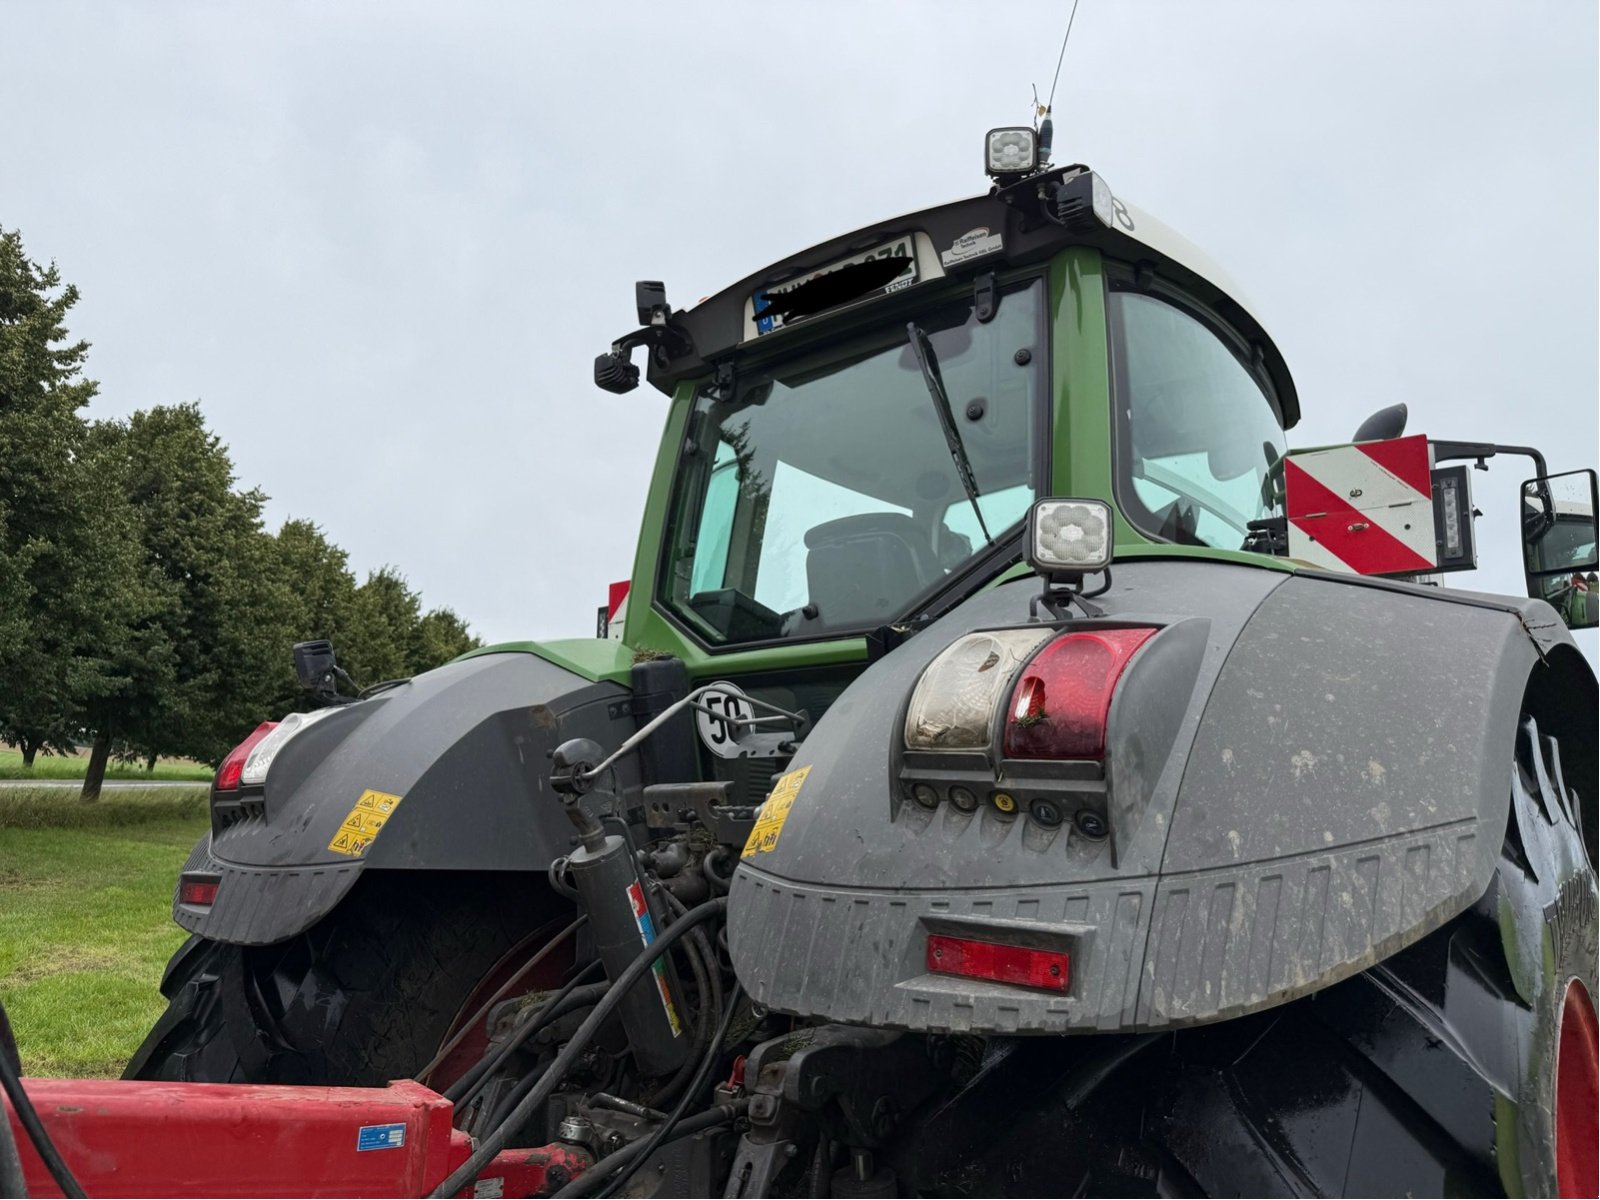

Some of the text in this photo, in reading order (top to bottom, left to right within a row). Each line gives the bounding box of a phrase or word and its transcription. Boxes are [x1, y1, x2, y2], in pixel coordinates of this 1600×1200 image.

[1112, 195, 1135, 232] 8
[959, 231, 987, 244] Raiffeisen
[884, 278, 914, 294] FENDT
